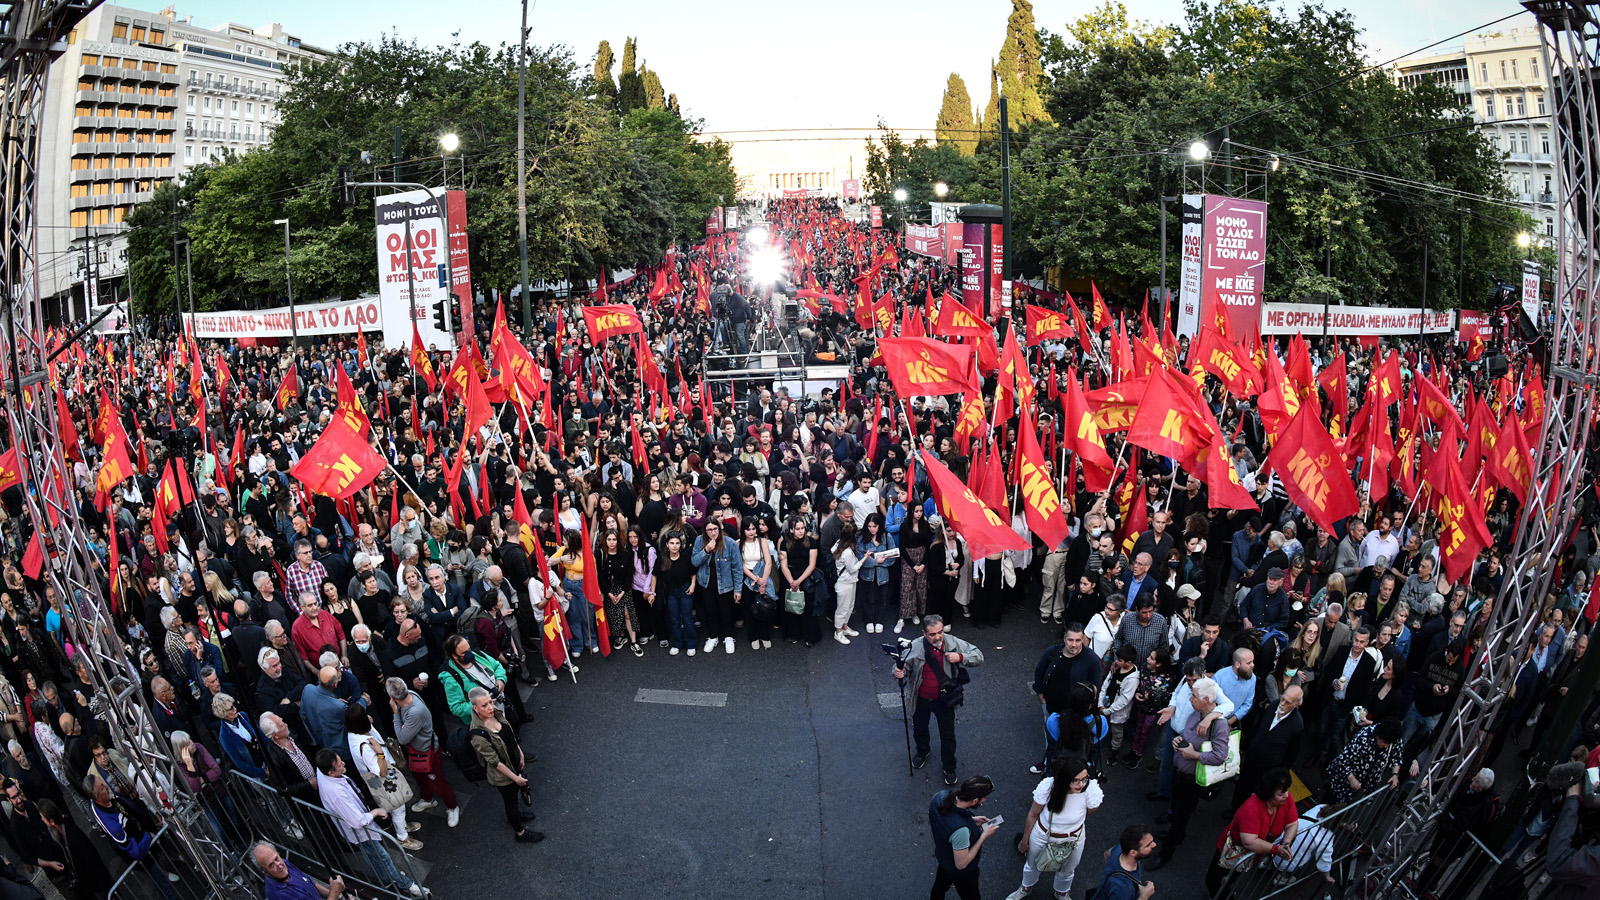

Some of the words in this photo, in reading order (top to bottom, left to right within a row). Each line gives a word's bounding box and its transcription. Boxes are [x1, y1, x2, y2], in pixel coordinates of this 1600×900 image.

[414, 204, 438, 215] ΤΟΥΣ
[1216, 216, 1247, 228] ΜΟΝΟ
[1216, 227, 1225, 236] Ο
[1227, 228, 1254, 239] ΛΑΟΣ
[386, 228, 437, 252] ΟΛΟΙ
[1184, 234, 1200, 246] ΟΛΟΙ
[1216, 237, 1247, 249] ΣΩΖΕΙ
[1185, 245, 1200, 257] ΜΑΣ
[1216, 248, 1238, 260] ΤΟΝ
[1239, 250, 1259, 261] ΛΑΟ
[390, 249, 437, 272] ΜΑΣ
[386, 270, 438, 283] #ΤΩΡΑ_ΚΚ
[1216, 277, 1233, 289] ΜΕ
[1235, 277, 1255, 290] ΚΚΕ
[1524, 278, 1538, 289] ΟΛΟΙ
[1524, 288, 1537, 298] ΜΑΣ
[1219, 294, 1256, 306] ΥΝΑΤΟ
[219, 314, 256, 332] ΔΥΝΑΤΟ
[263, 312, 293, 331] ΝΙΚΗ
[294, 310, 317, 330] ΓΙΑ
[319, 307, 339, 327] ΤΟ
[344, 303, 378, 326] ΛΑΟ
[596, 312, 631, 332] ΚΚΕ
[1267, 311, 1284, 326] ΜΕ
[1286, 311, 1314, 327] ΟΡΓΗ
[1317, 312, 1332, 327] ΜΕ
[1332, 313, 1365, 328] ΚΑΡΔΙΑ
[1368, 314, 1380, 328] ΜΕ
[1381, 314, 1406, 328] ΜΥΑΛΟ
[1036, 315, 1061, 336] ΚΚΕ
[1209, 348, 1242, 382] ΚΚΕ
[1287, 447, 1331, 513] ΚΚΕ
[1021, 452, 1060, 522] ΚΚΕ
